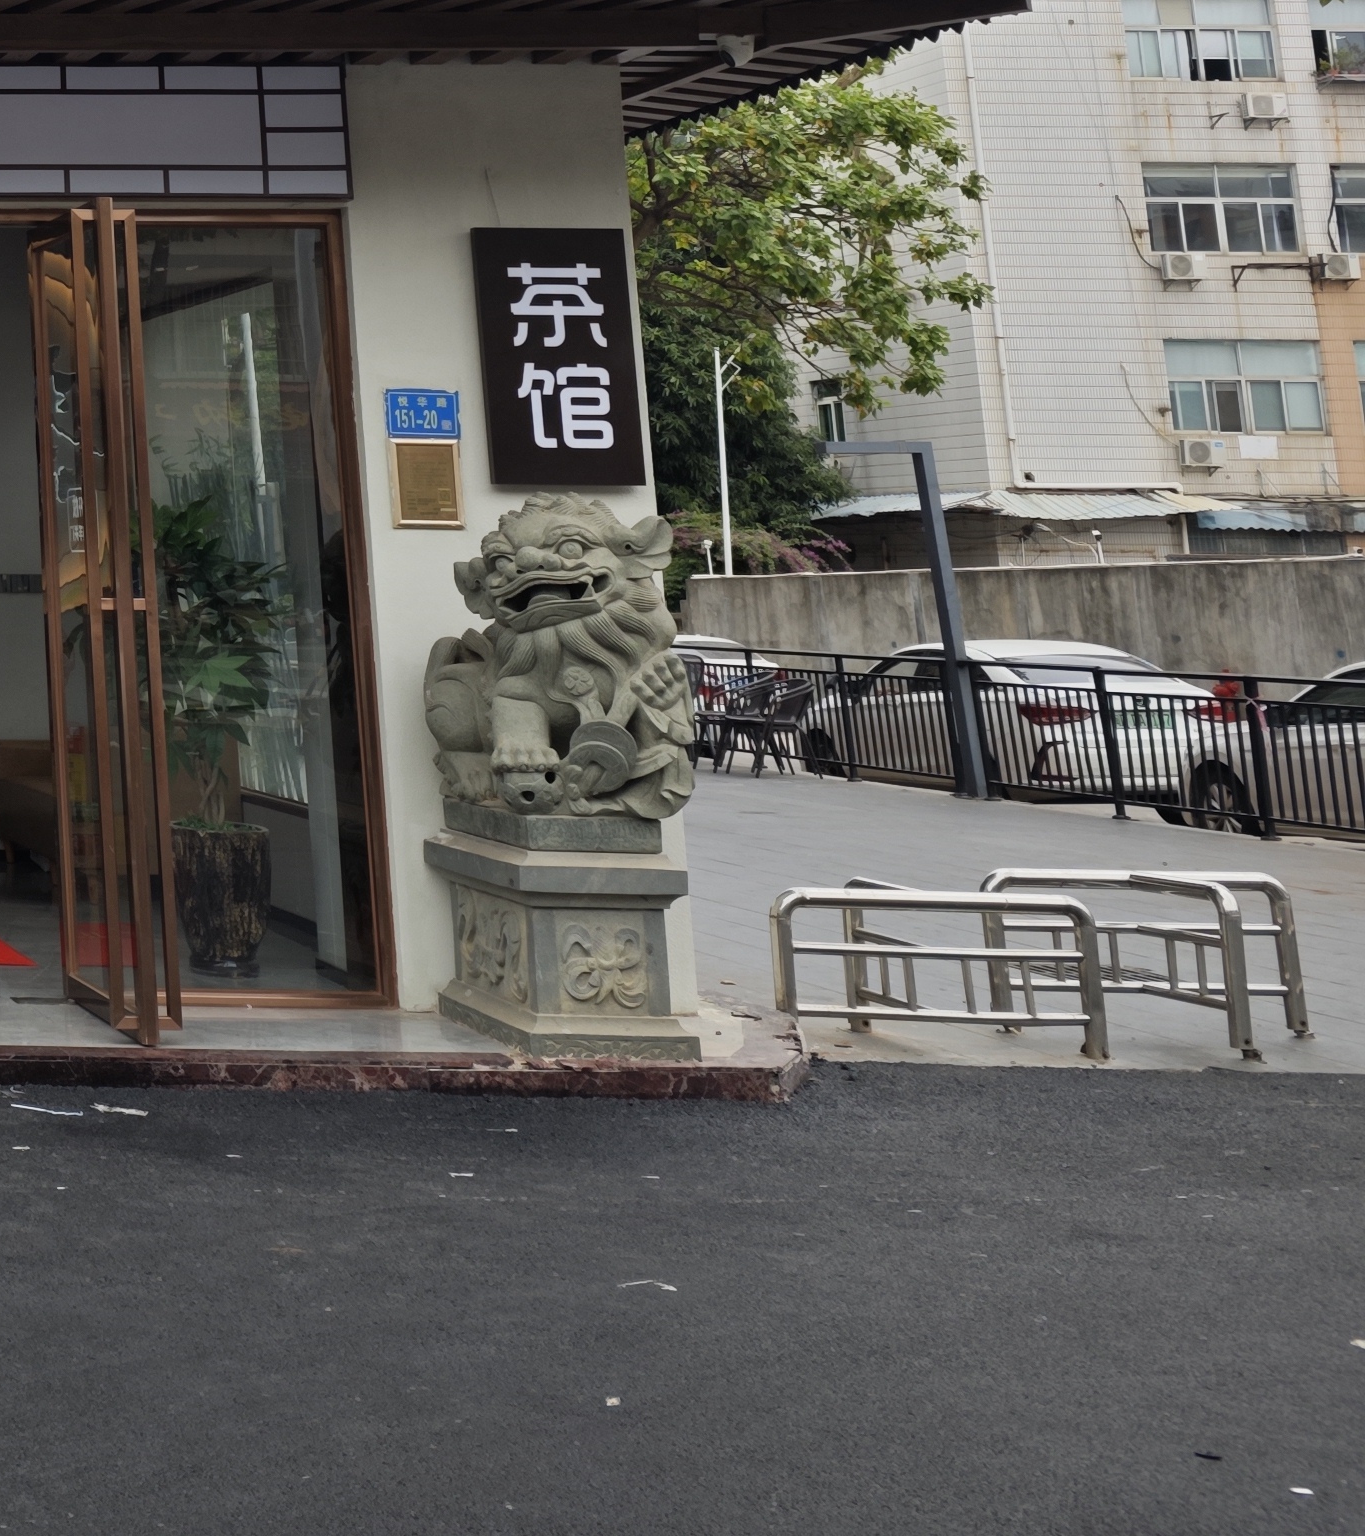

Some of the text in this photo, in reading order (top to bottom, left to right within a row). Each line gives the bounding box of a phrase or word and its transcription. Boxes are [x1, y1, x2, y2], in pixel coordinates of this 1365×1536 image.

[506, 262, 615, 449] 茶馆
[397, 396, 447, 408] 悦华路
[395, 409, 438, 429] 151-20
